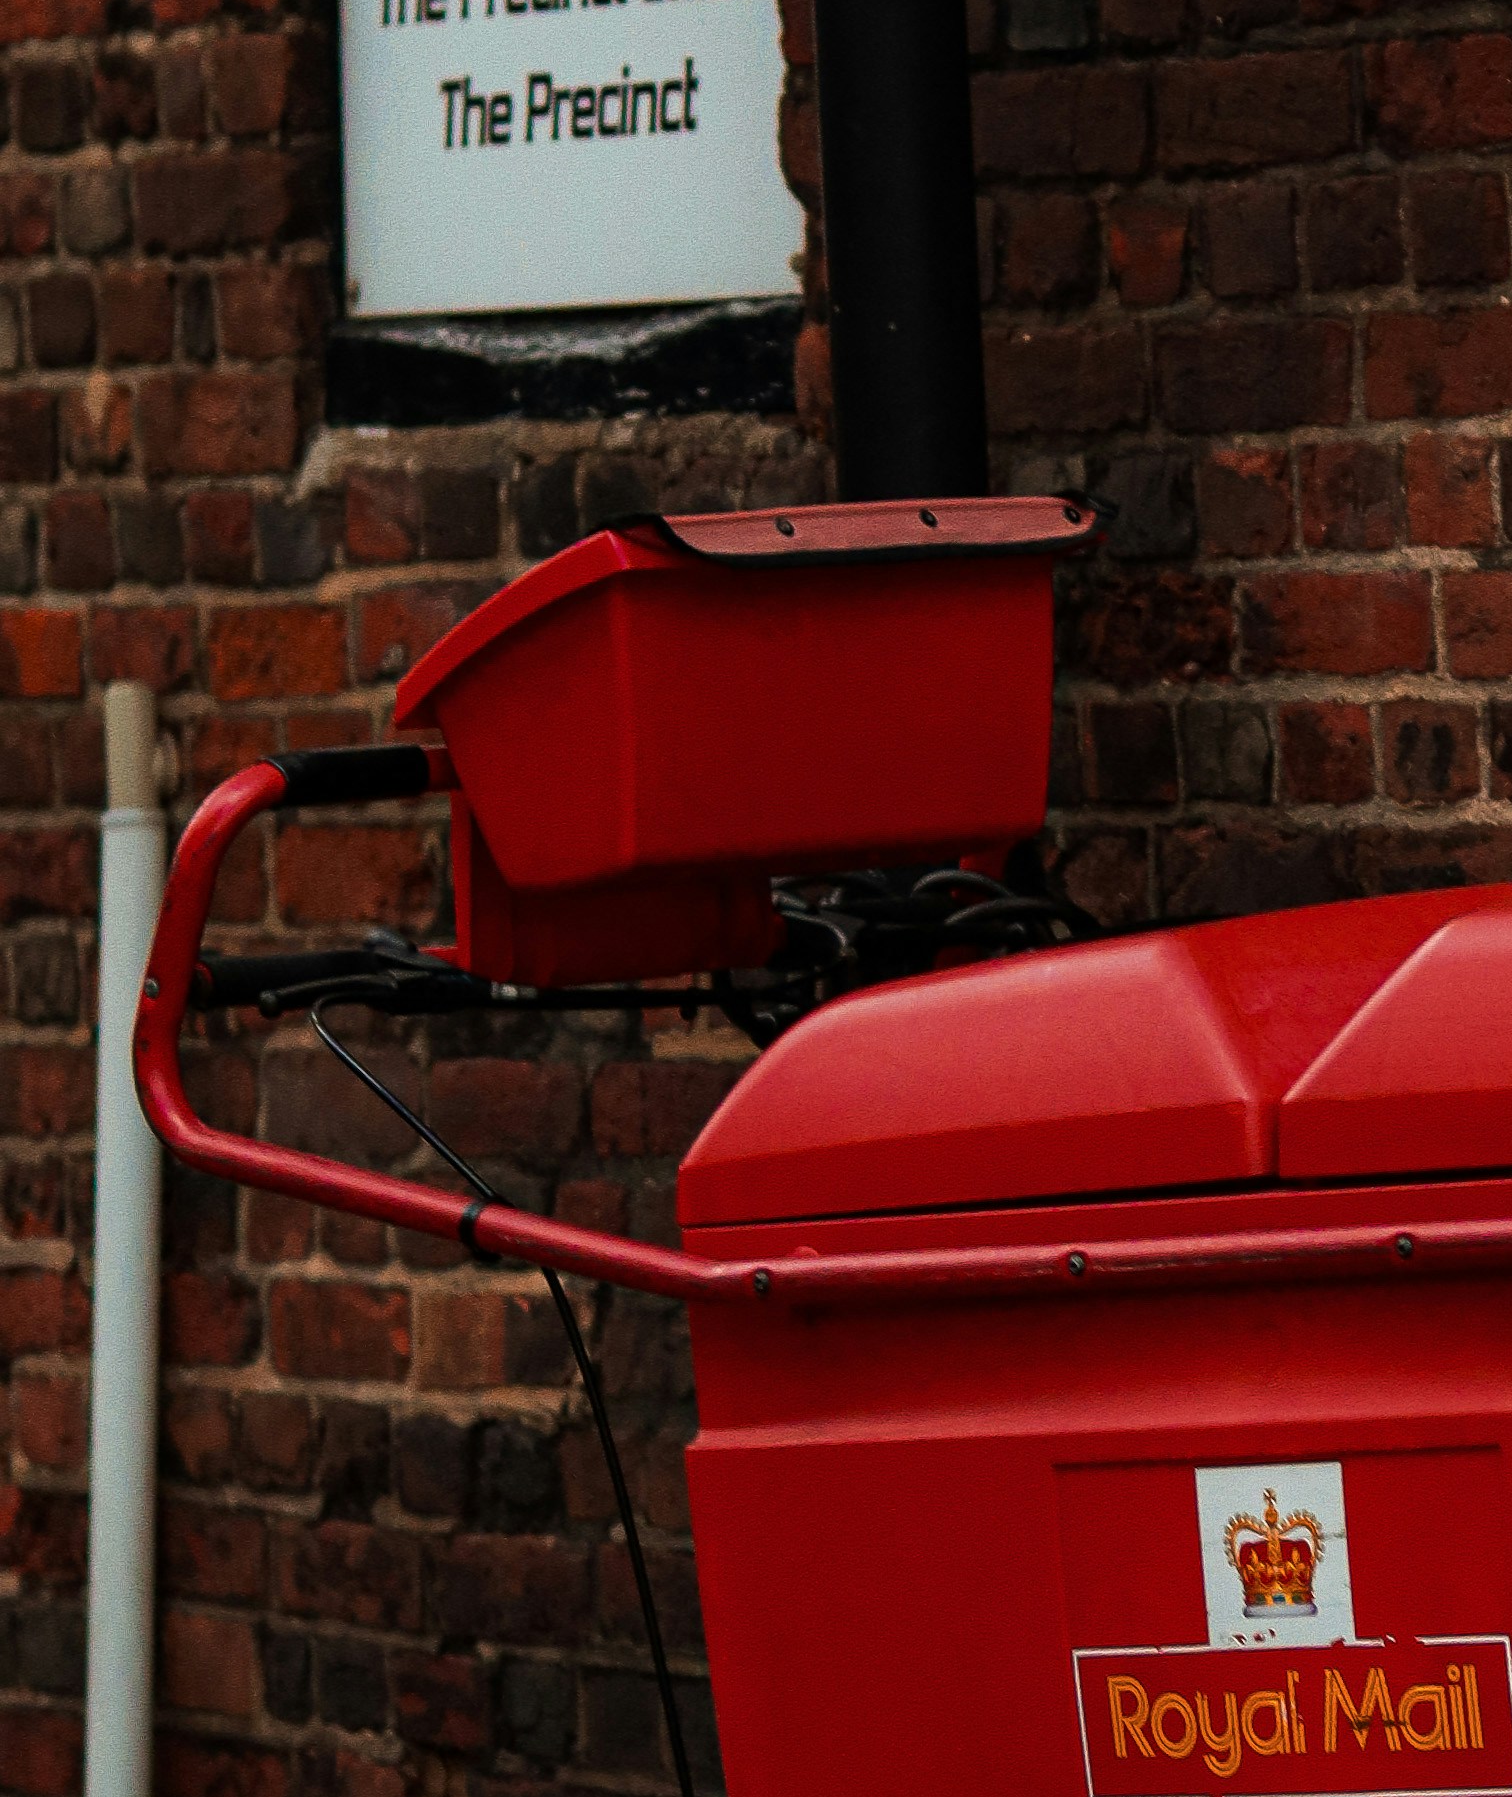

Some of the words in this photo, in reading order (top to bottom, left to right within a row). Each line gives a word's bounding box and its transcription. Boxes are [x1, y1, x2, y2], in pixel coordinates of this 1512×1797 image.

[440, 74, 513, 150] The
[525, 55, 699, 143] Precinct
[1106, 1669, 1308, 1778] Royal
[1324, 1663, 1485, 1754] Mail
